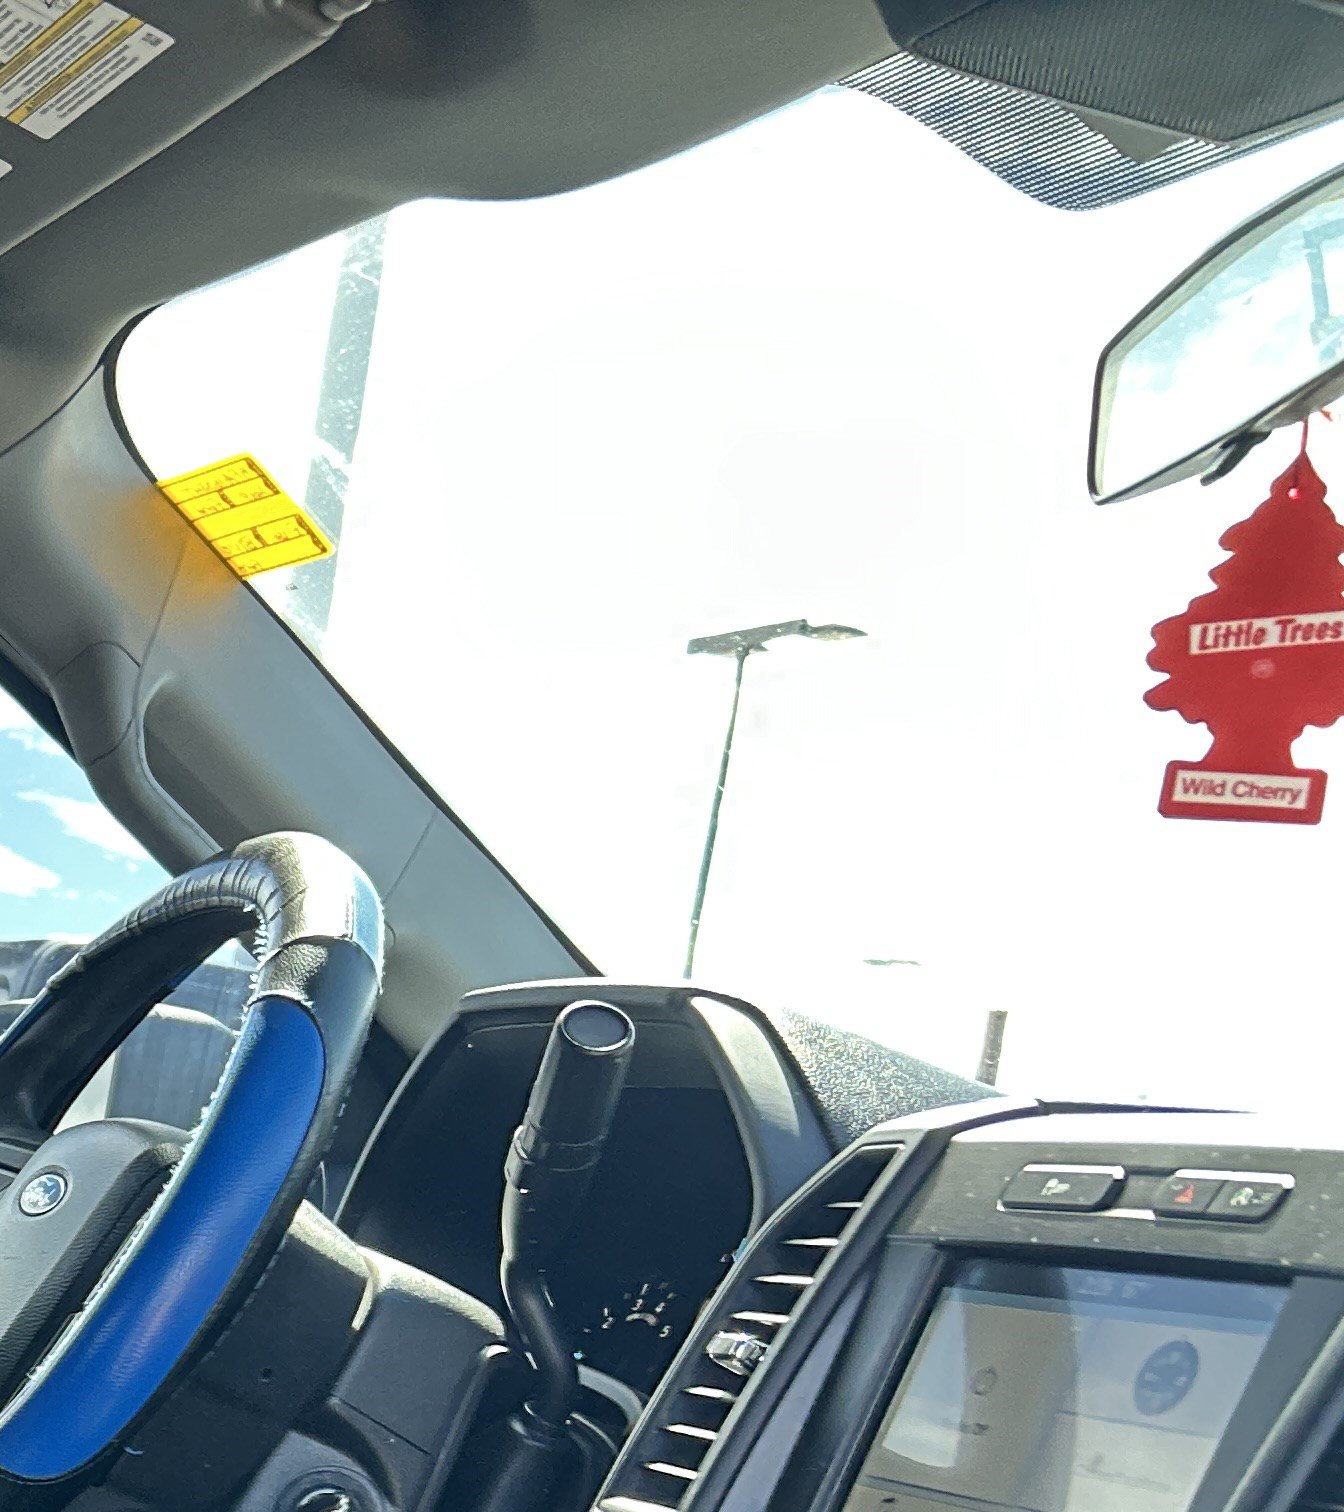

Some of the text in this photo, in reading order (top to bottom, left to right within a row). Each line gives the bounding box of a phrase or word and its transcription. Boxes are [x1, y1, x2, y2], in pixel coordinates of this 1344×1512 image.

[1198, 618, 1344, 650] Little Trees
[1182, 778, 1303, 805] Wild Cherry
